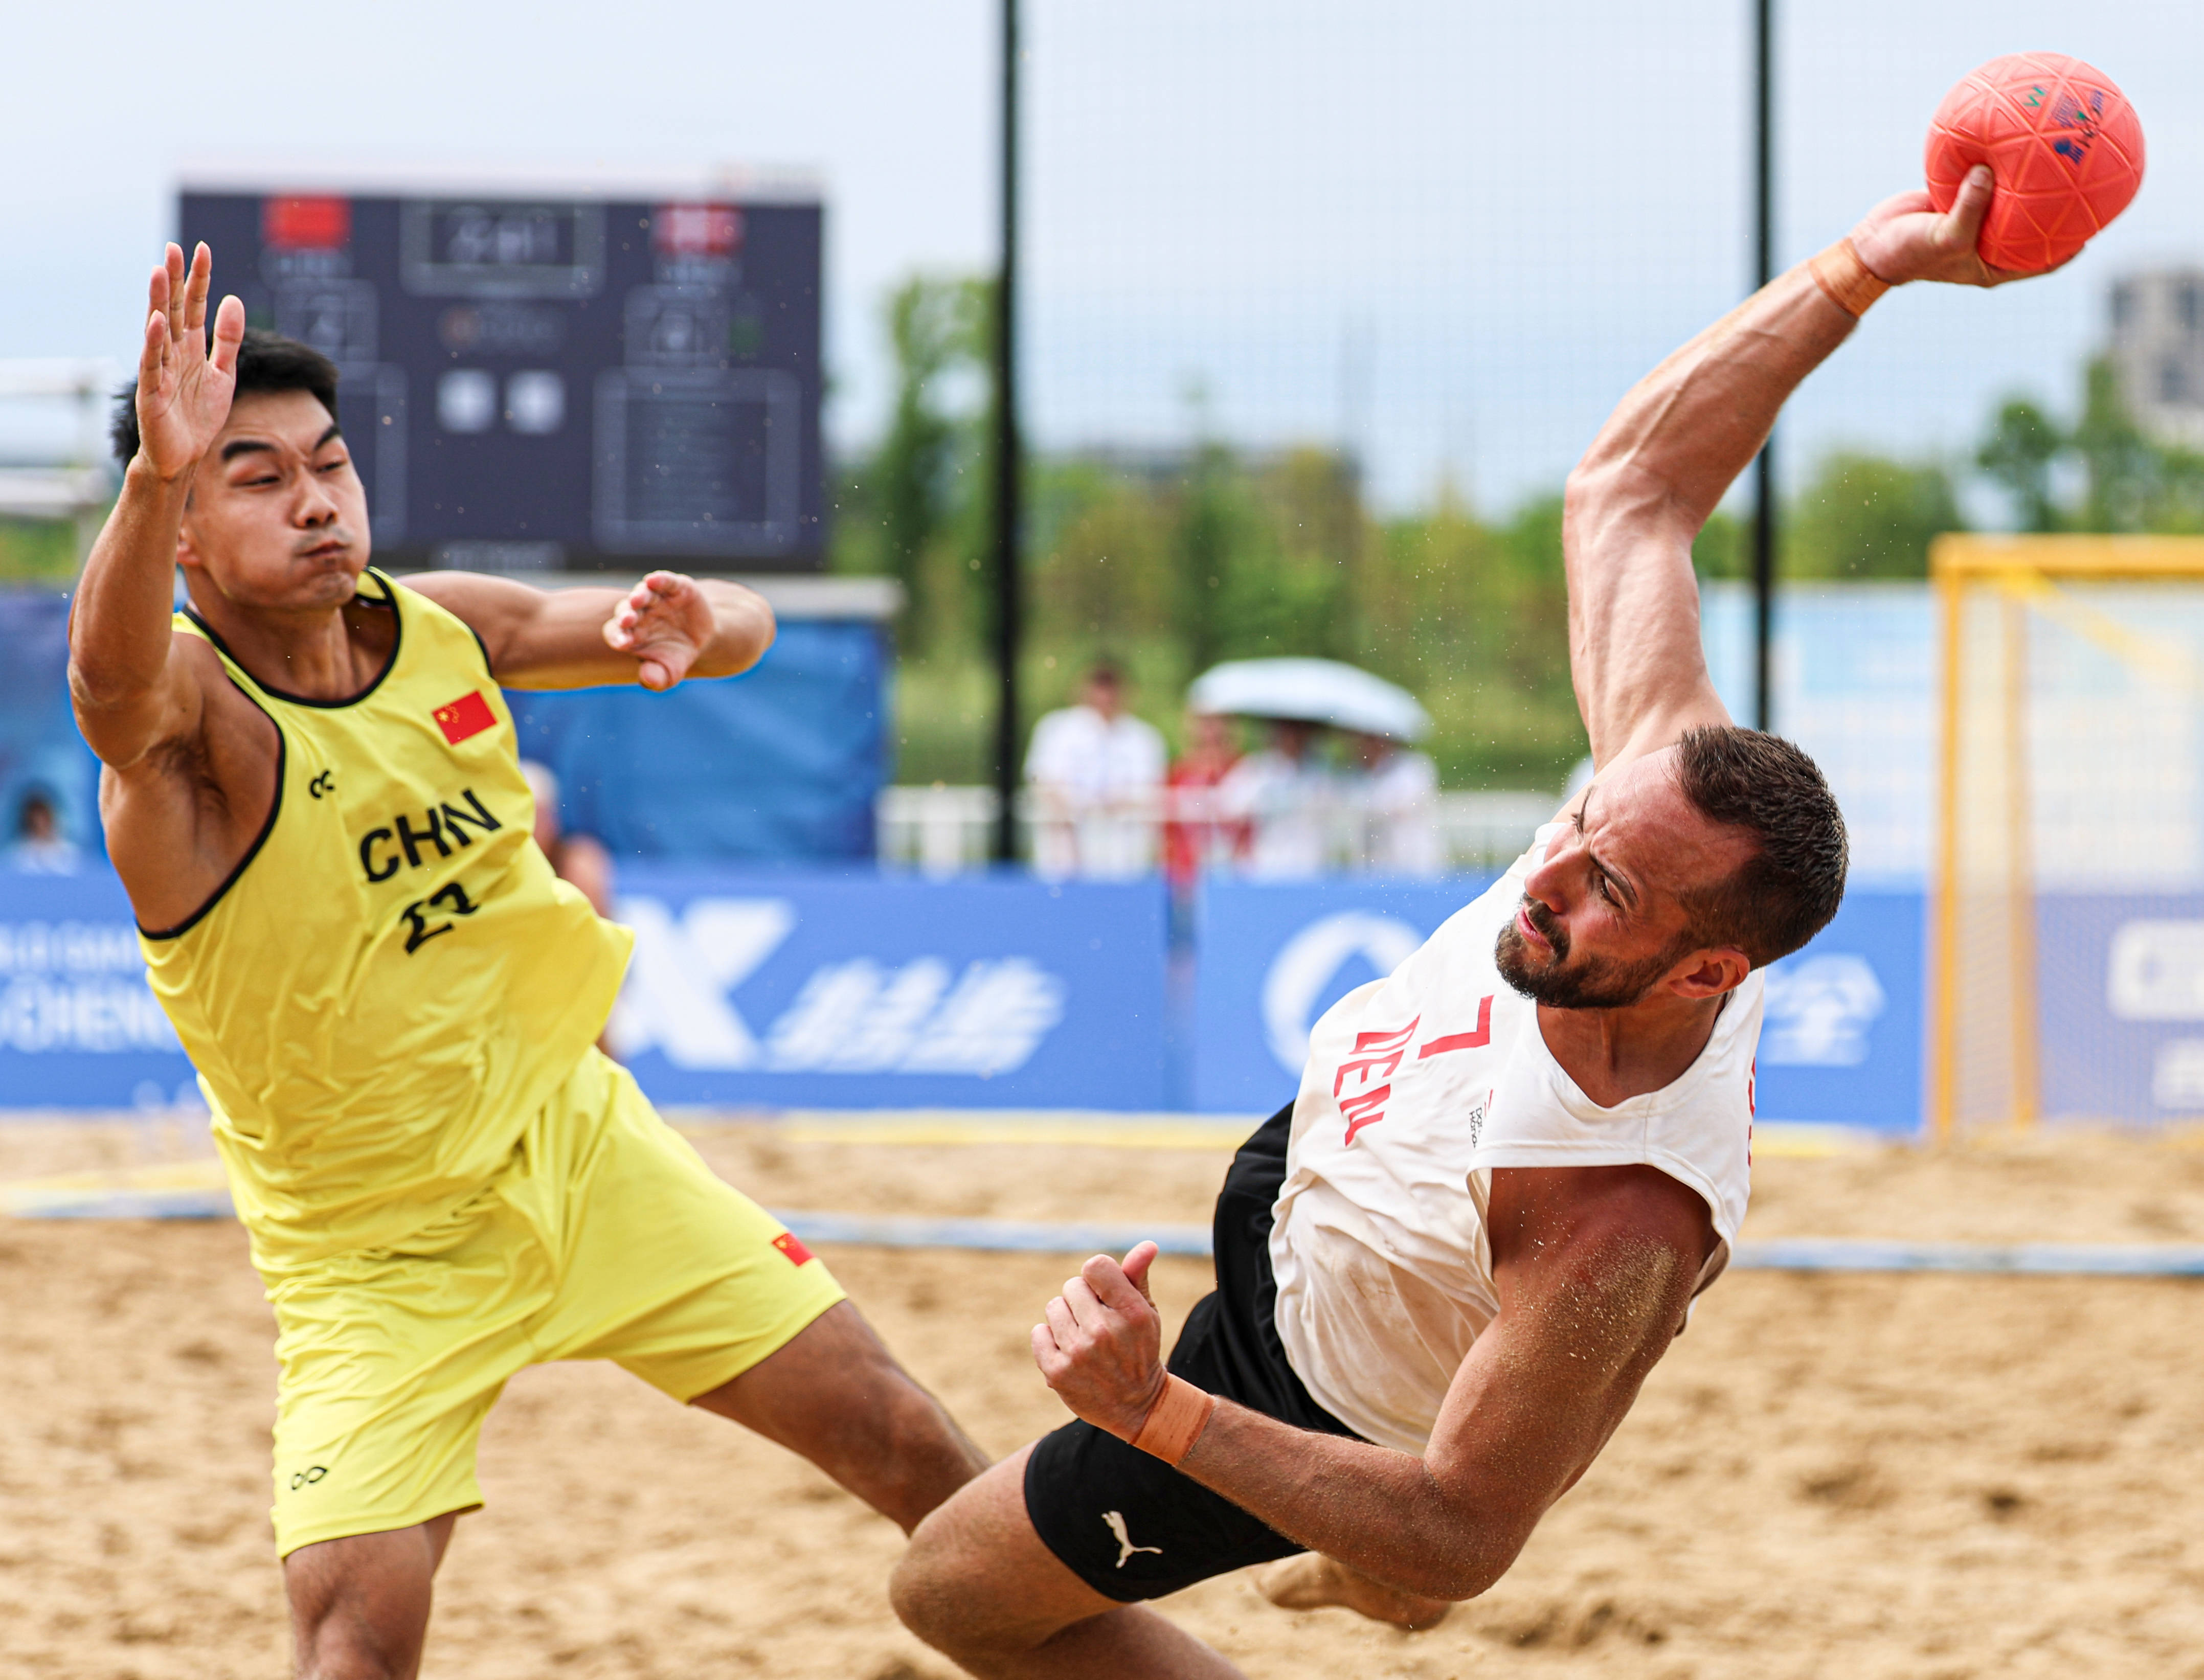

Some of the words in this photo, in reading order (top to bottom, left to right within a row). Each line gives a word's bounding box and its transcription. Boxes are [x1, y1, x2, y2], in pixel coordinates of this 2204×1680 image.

[358, 787, 503, 883] CHN
[1418, 994, 1494, 1059] 7
[1333, 1013, 1421, 1147] DEN
